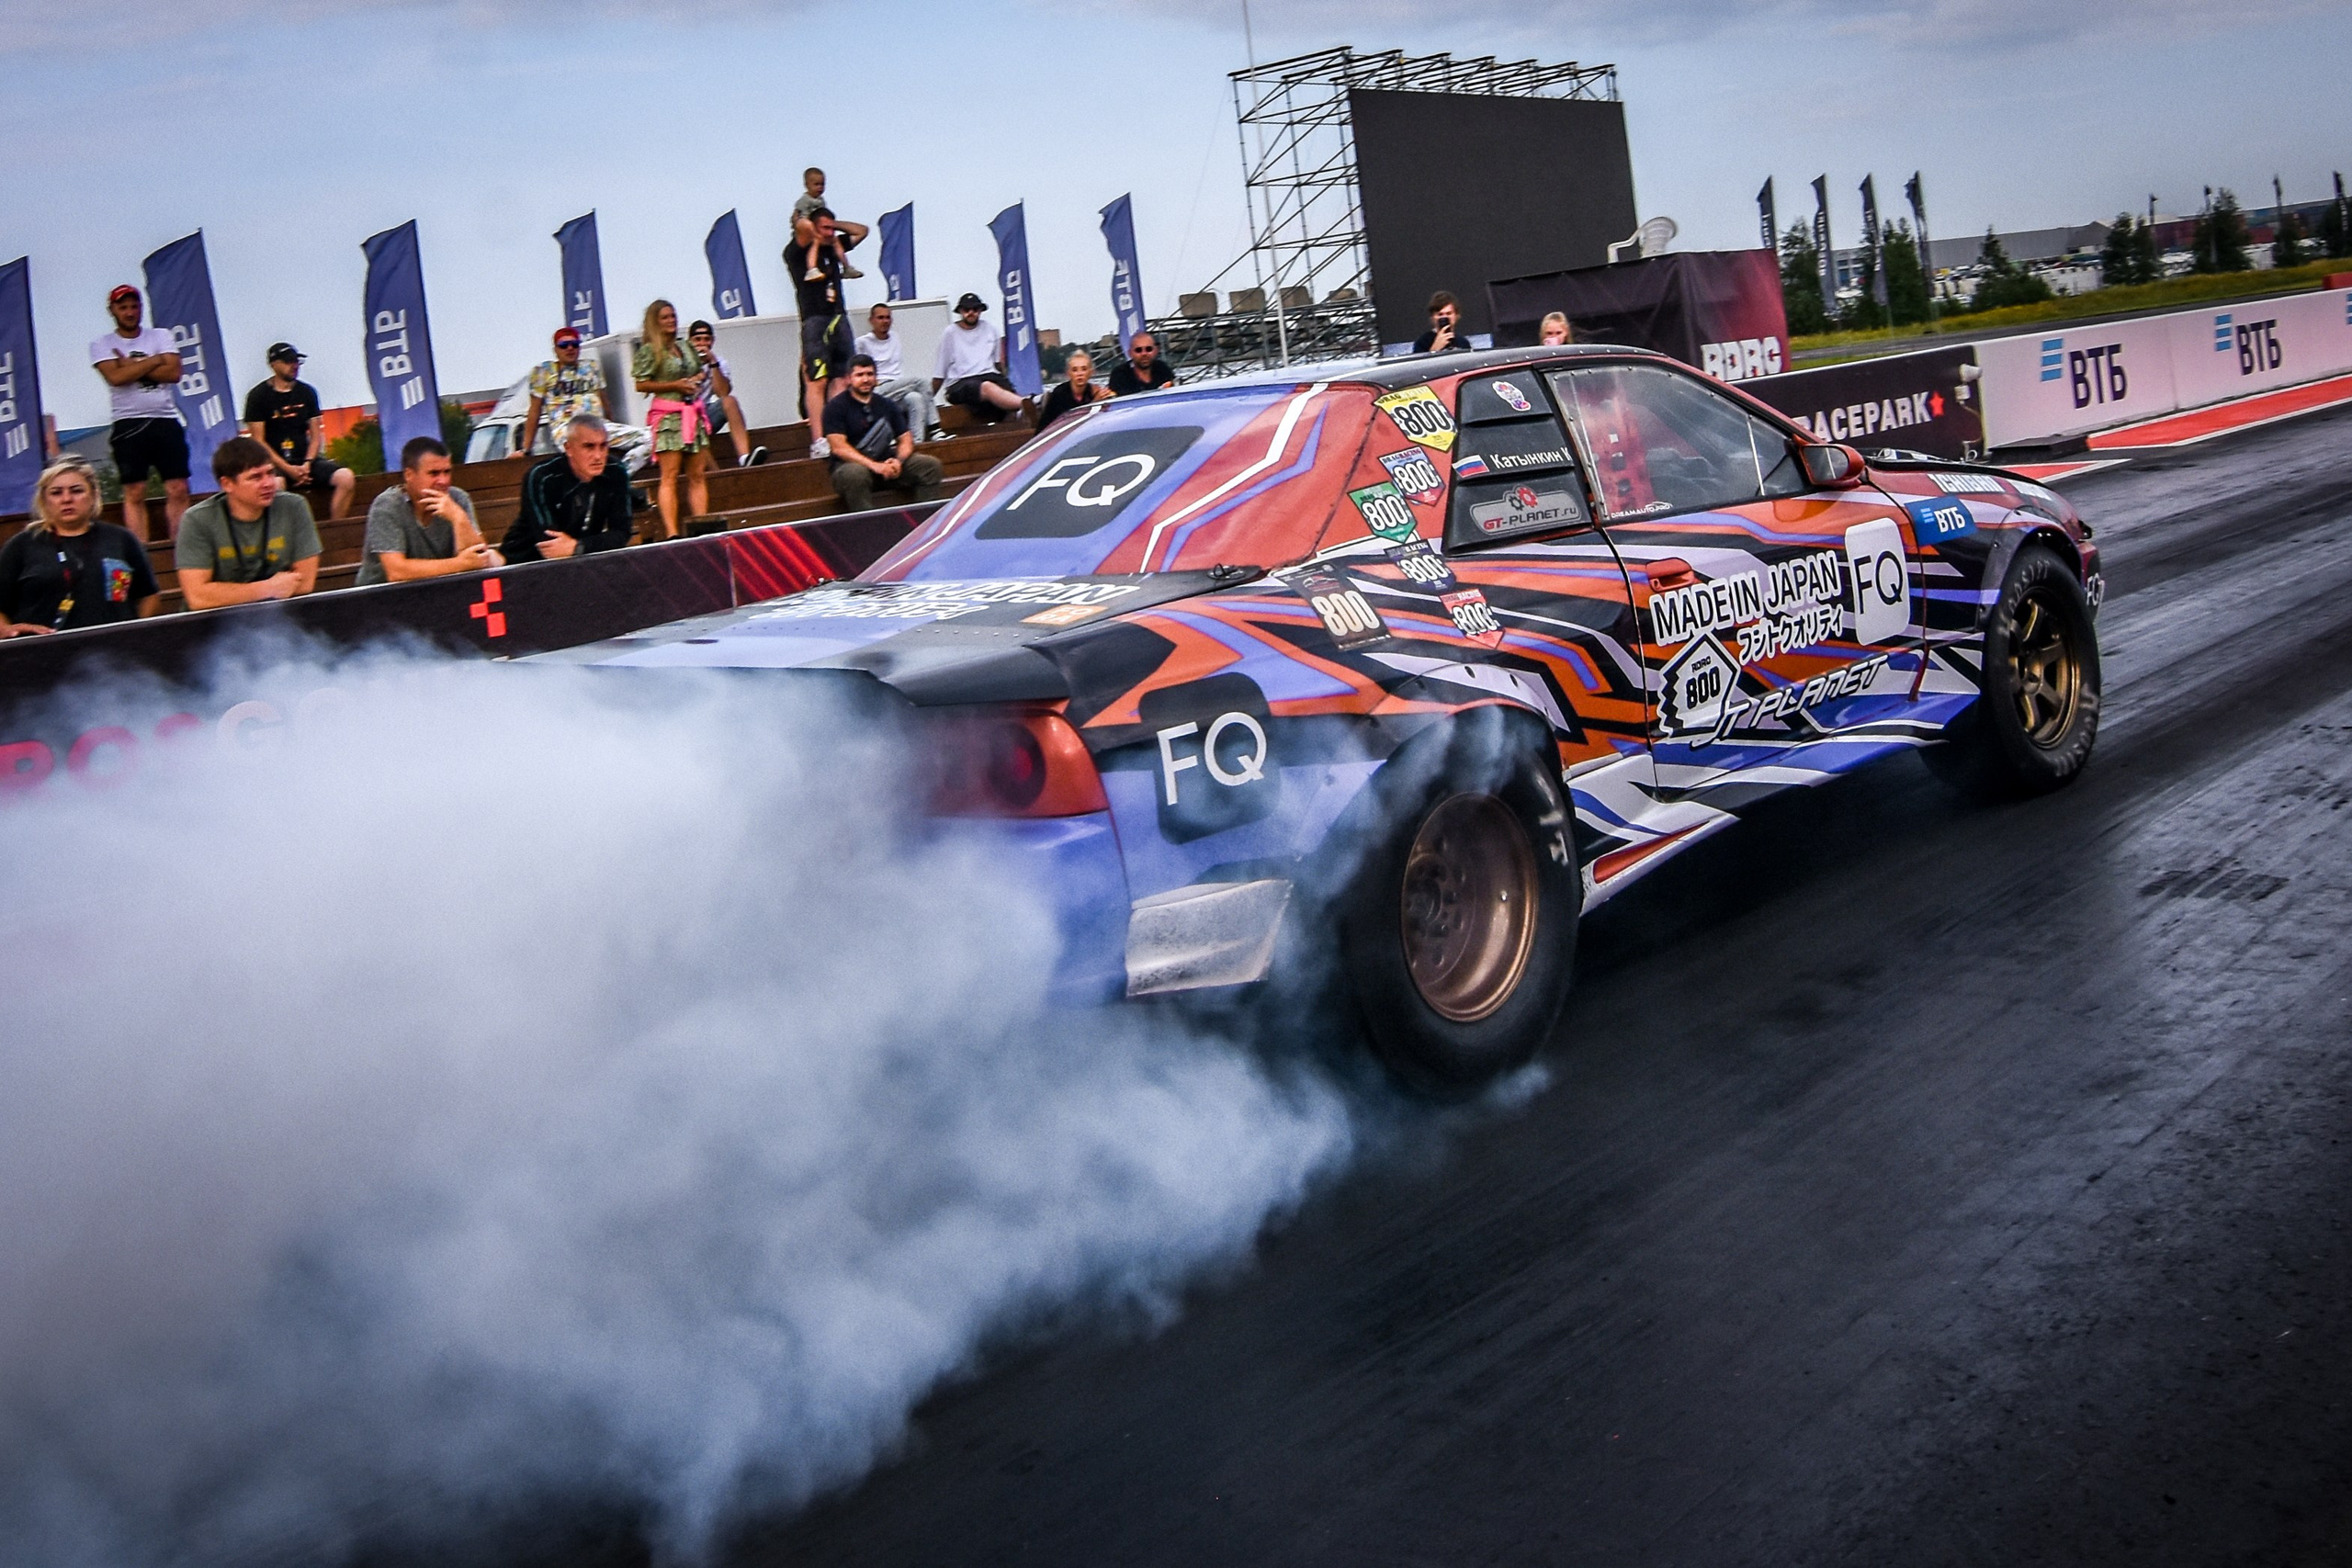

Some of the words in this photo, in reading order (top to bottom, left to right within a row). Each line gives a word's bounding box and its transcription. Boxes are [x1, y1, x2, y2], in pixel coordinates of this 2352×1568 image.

[2235, 319, 2284, 377] ВТБ
[2069, 343, 2128, 410] ВТБ
[1393, 400, 1453, 435] 800
[1381, 455, 1400, 464] DRAG
[1398, 447, 1422, 459] RACING
[1393, 459, 1440, 495] 800
[1489, 449, 1564, 470] Катынкин
[1006, 453, 1157, 512] FQ
[1362, 495, 1409, 532] 800
[1933, 506, 1966, 534] ВТБ
[1398, 554, 1449, 582] 800
[1853, 549, 1905, 615] FQ
[1311, 590, 1380, 637] 800
[1452, 602, 1498, 636] 800
[1653, 582, 1732, 640] MADE
[1733, 575, 1762, 624] IN
[1766, 554, 1839, 609] JAPAN
[1685, 666, 1721, 710] 800
[1749, 654, 1890, 728] PLANET
[1156, 711, 1268, 807] FQ
